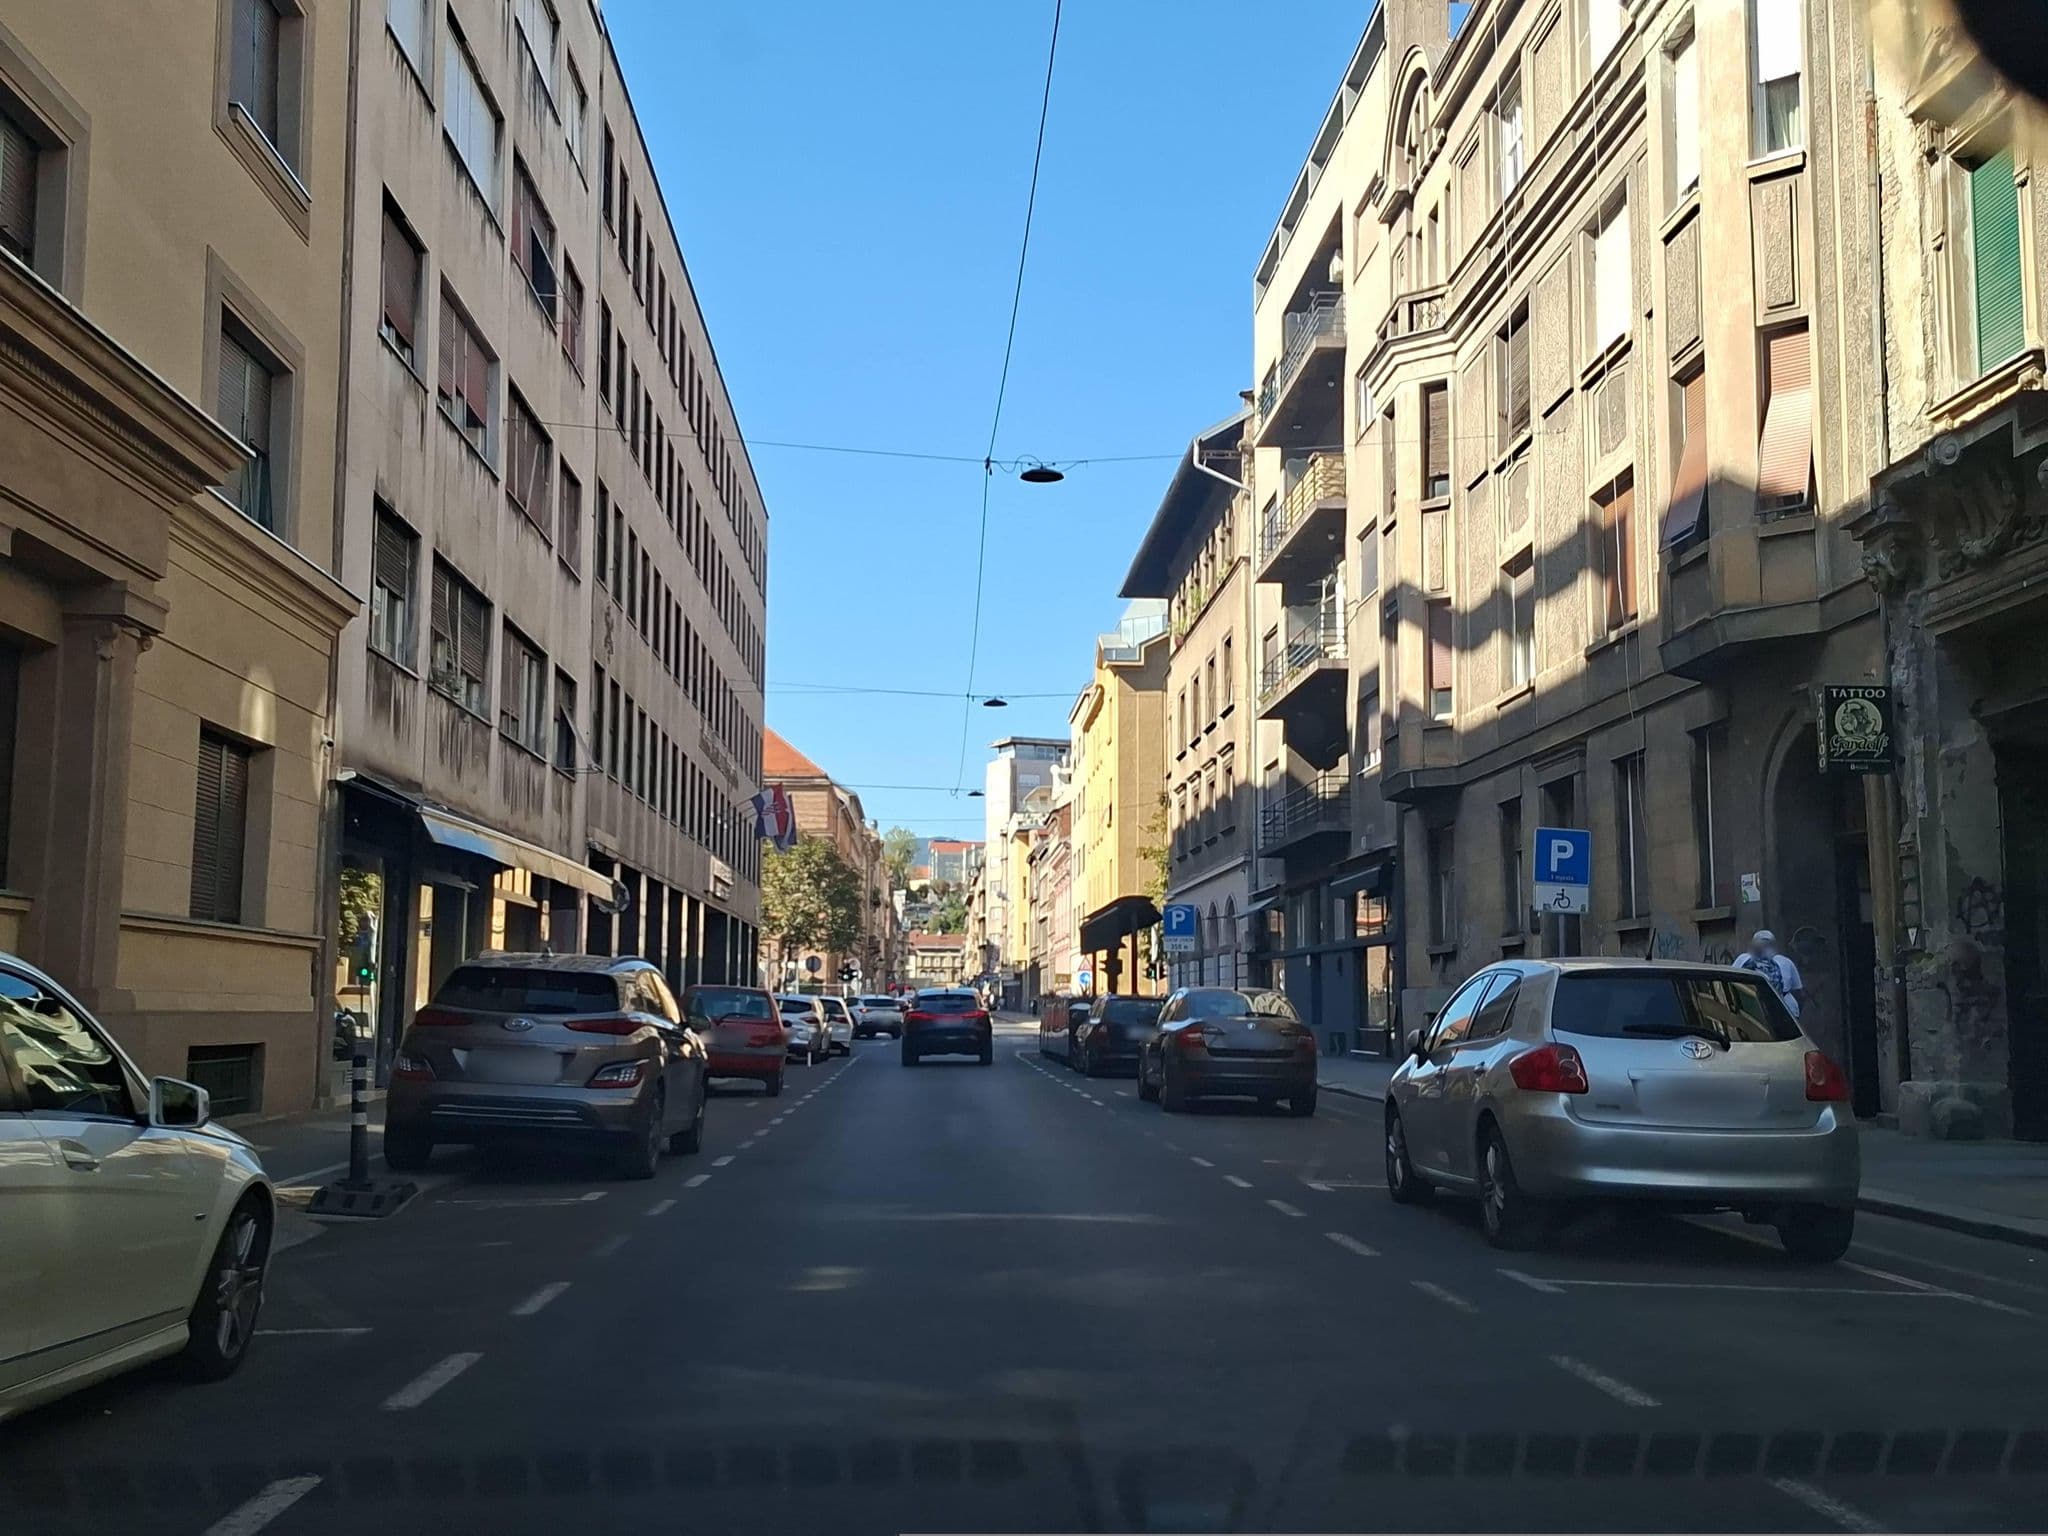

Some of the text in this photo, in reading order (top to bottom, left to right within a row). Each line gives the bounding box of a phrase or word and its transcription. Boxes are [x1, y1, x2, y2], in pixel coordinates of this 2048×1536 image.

[1830, 688, 1886, 698] TATTOO
[1551, 839, 1574, 872] P
[1172, 911, 1185, 930] P
